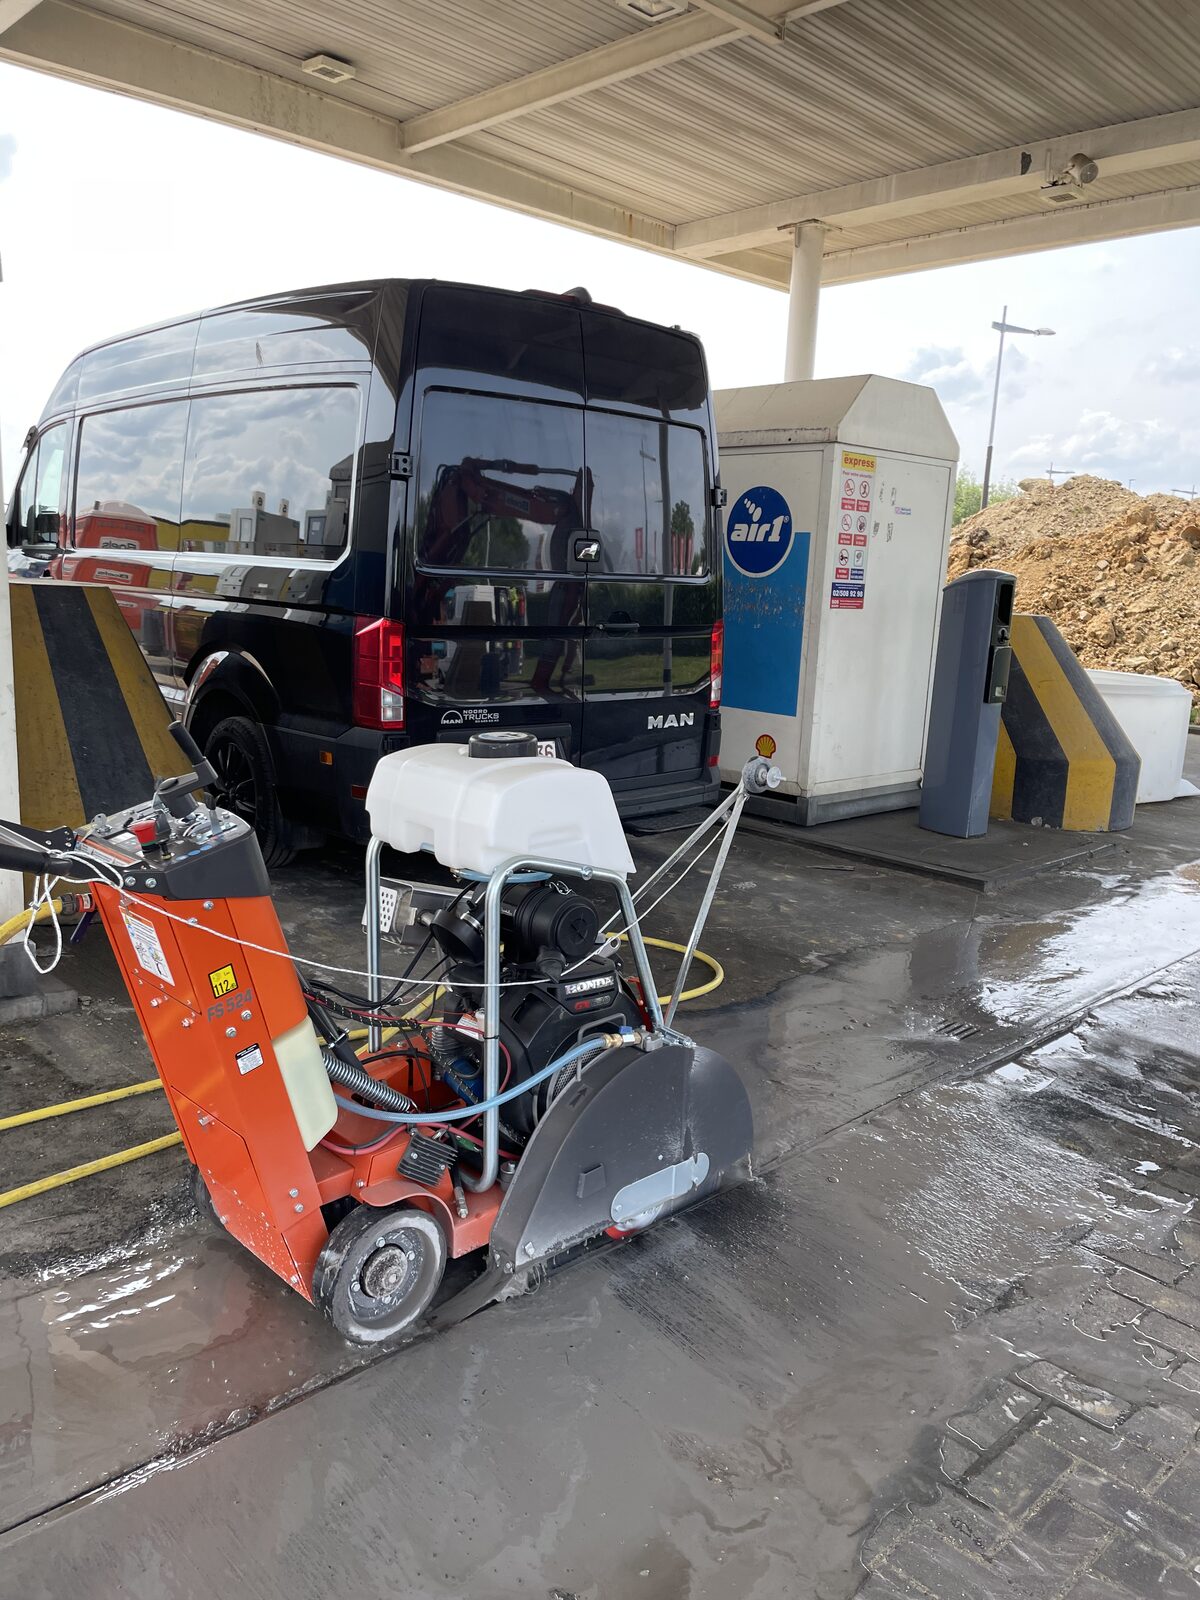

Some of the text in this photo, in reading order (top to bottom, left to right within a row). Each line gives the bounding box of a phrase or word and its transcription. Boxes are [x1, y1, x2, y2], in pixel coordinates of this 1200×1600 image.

[844, 455, 875, 469] express
[648, 713, 695, 730] MAN
[214, 980, 231, 995] 112
[564, 976, 615, 995] HONDA
[207, 988, 254, 1022] FS 524
